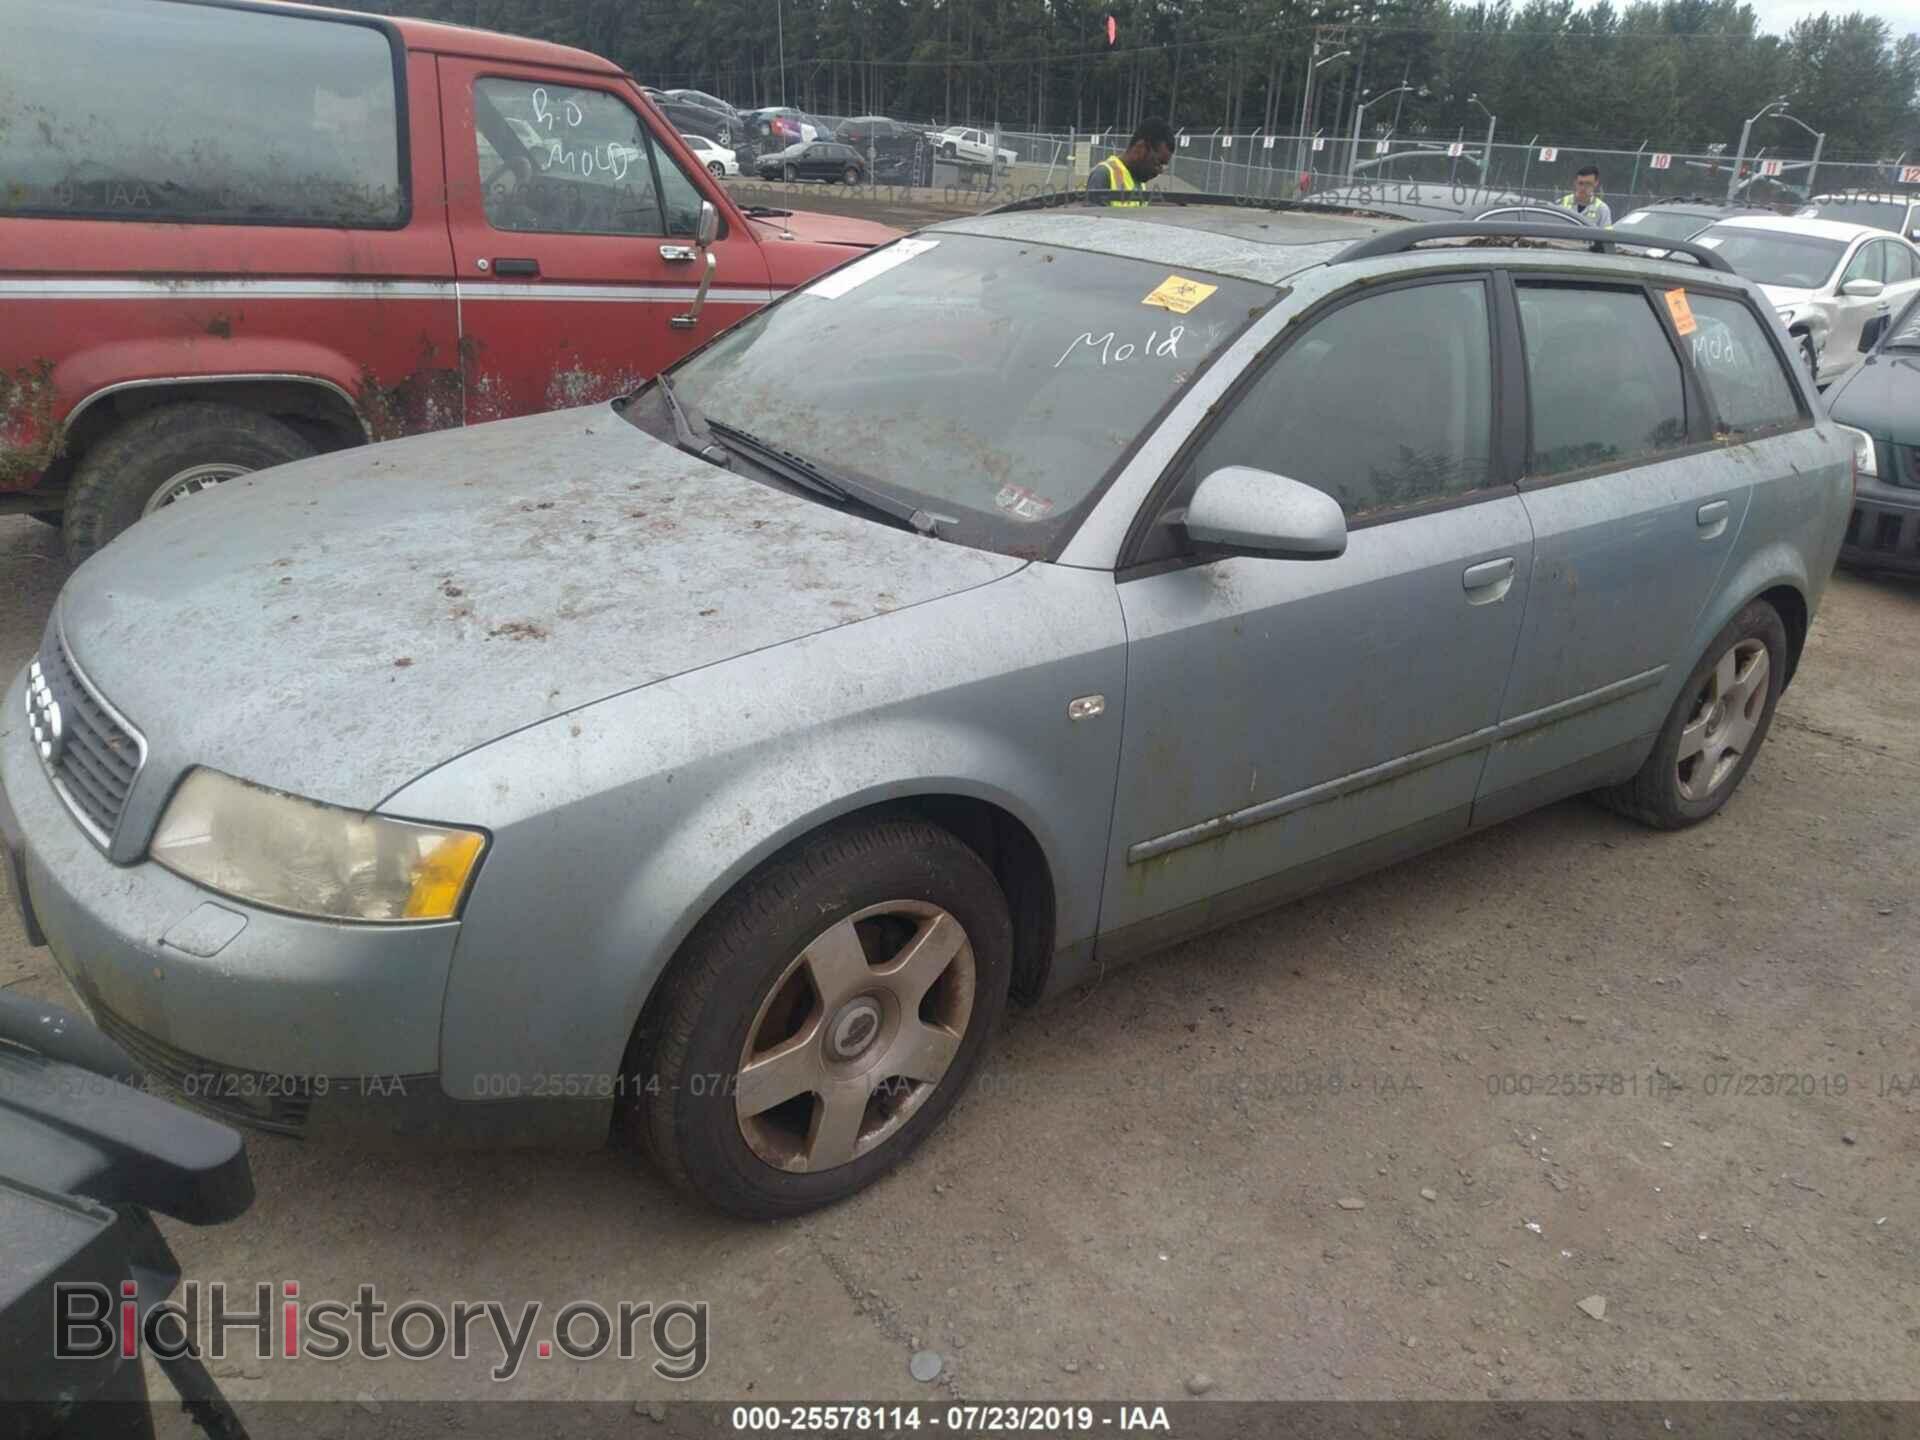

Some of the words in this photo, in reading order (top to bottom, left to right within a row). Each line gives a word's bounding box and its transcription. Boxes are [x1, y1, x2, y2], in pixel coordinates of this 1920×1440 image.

[1544, 148, 1553, 160] 9
[1656, 155, 1668, 169] 10
[1767, 162, 1778, 174] 11
[1904, 168, 1920, 182] 12
[1053, 325, 1185, 368] Mold
